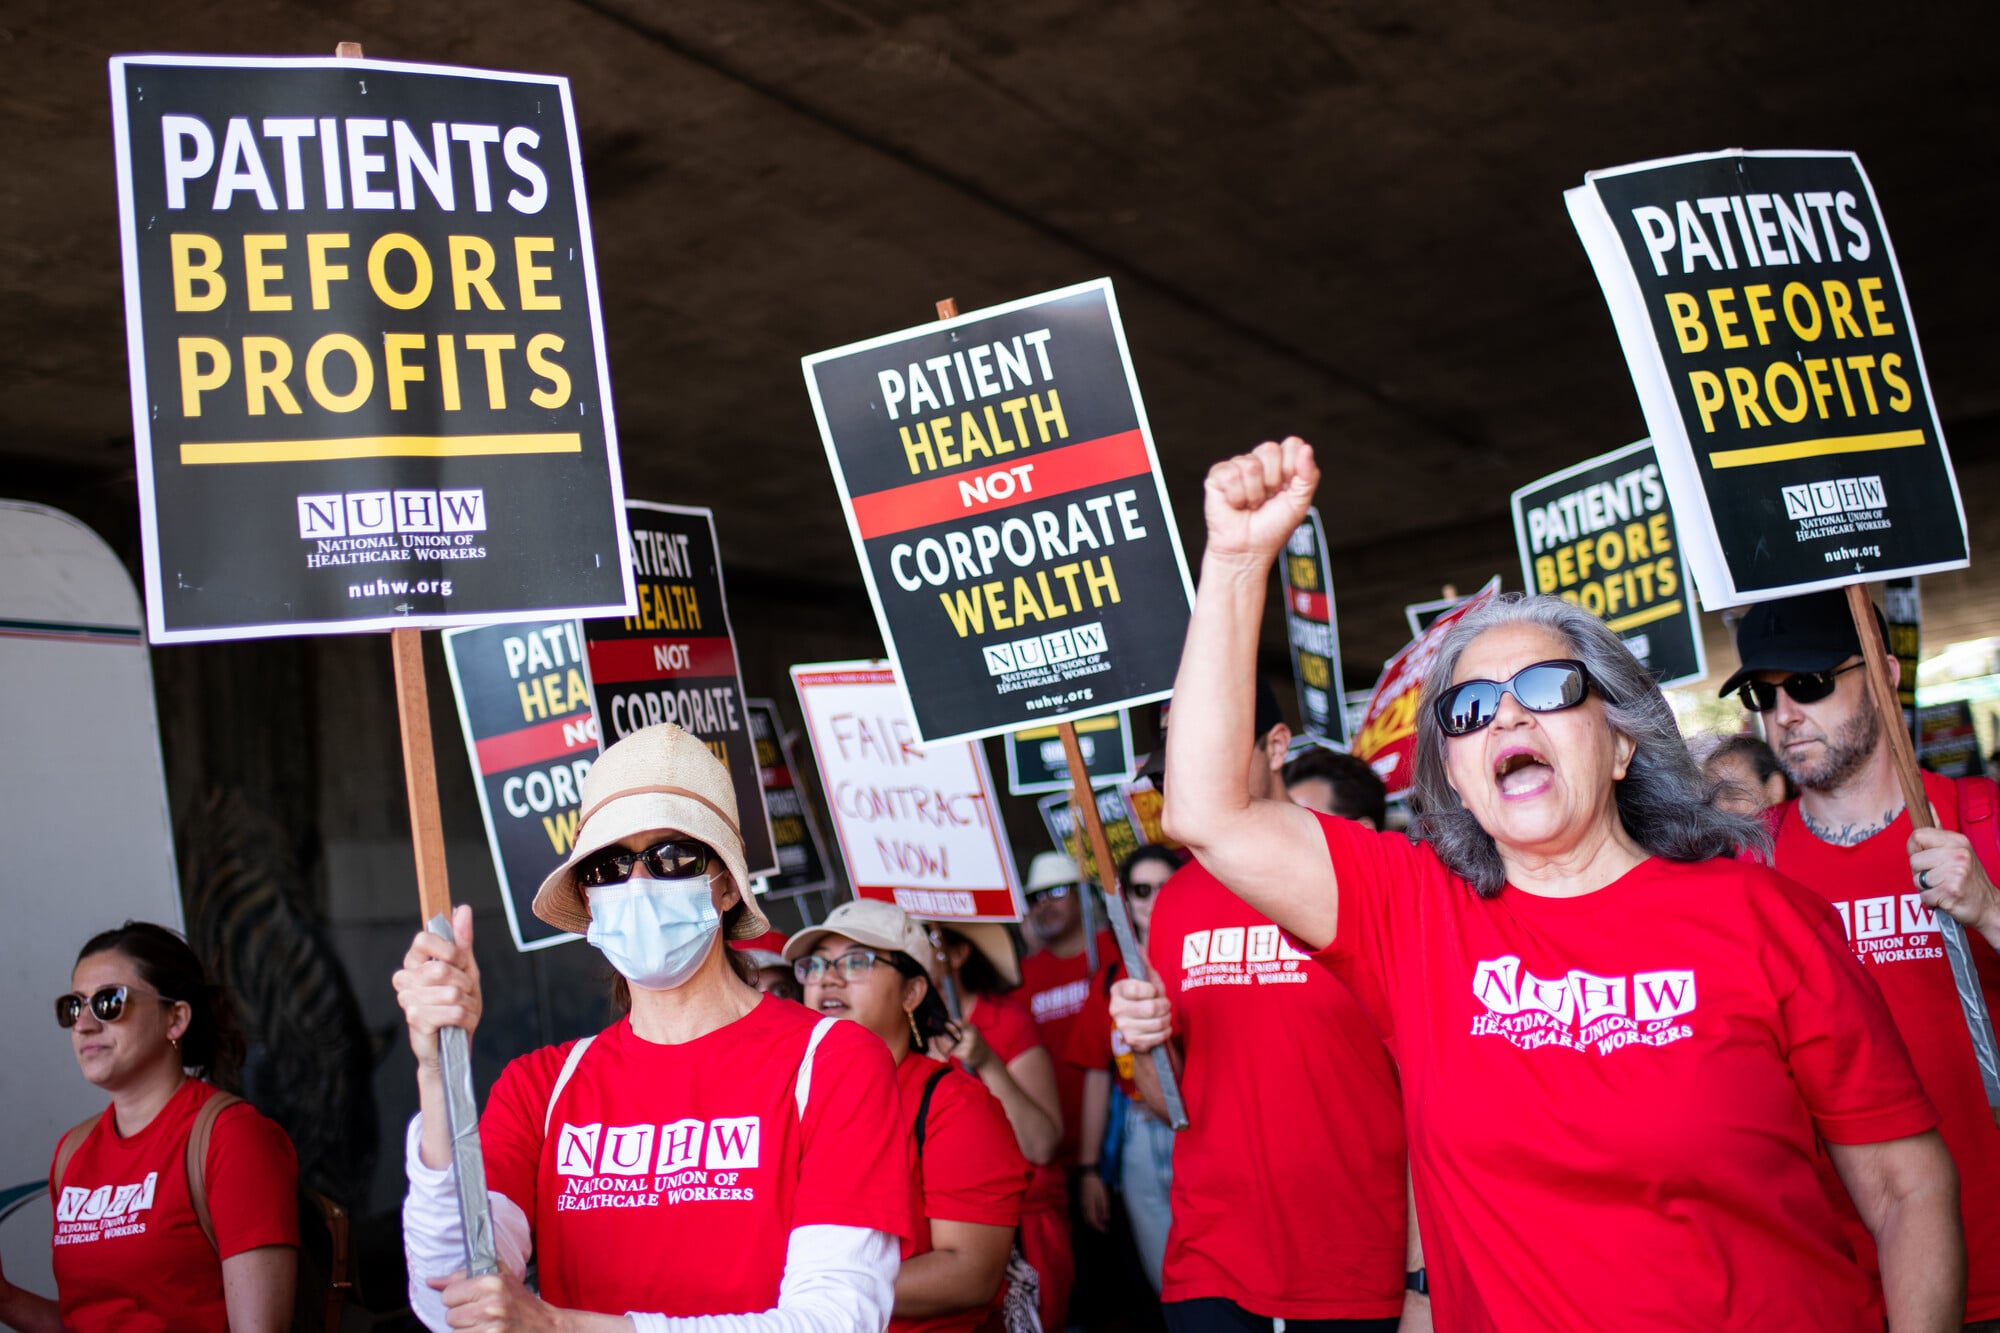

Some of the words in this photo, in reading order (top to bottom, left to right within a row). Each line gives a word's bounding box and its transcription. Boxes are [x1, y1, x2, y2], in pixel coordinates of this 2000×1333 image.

[161, 115, 548, 215] PATIENTS
[1632, 191, 1871, 276] PATIENTS
[170, 232, 562, 312] BEFORE
[1665, 277, 1895, 354] BEFORE
[177, 333, 573, 417] PROFITS
[878, 328, 1054, 420] PATIENT
[1688, 353, 1912, 433] PROFITS
[899, 389, 1069, 475] HEALTH
[958, 464, 1034, 507] NOT
[1528, 463, 1664, 554] PATIENTS
[1781, 475, 1888, 520] NUHW
[297, 489, 487, 538] NUHW
[1796, 522, 1855, 542] HEALTHCARE
[1856, 518, 1892, 532] WORKERS
[1799, 514, 1847, 531] NATIONAL
[1847, 510, 1872, 523] UNION
[1873, 509, 1884, 519] OF
[307, 549, 410, 568] HEALTHCARE
[415, 547, 487, 561] WORKERS
[317, 537, 398, 553] NATIONAL
[402, 535, 451, 548] UNION
[454, 534, 474, 546] OF
[890, 490, 1147, 592] CORPORATE
[1535, 513, 1672, 593] BEFORE
[1824, 545, 1881, 562] nuhw.org
[349, 578, 453, 598] nuhw.org
[940, 556, 1121, 638] WEALTH
[1561, 556, 1678, 617] OFITS
[503, 622, 582, 679] PATI
[653, 644, 690, 671] NOT
[982, 621, 1109, 677] NUHW
[1001, 666, 1051, 683] NATIONAL
[1052, 658, 1086, 674] UNION
[1087, 653, 1101, 664] OF
[518, 668, 590, 722] HEA
[996, 675, 1060, 695] HEALTHCARE
[1062, 661, 1112, 681] WORKERS
[1026, 688, 1093, 710] nuhw.org
[562, 717, 598, 747] NO
[611, 687, 739, 740] CORPORATE
[831, 714, 925, 766] FAIR
[836, 781, 987, 828] CONTRACT
[876, 837, 949, 880] NOW
[1182, 924, 1312, 969] NUH
[1857, 936, 1904, 953] UNION
[1909, 935, 1929, 947] OF
[1872, 947, 1943, 965] WORKERS
[1473, 955, 1697, 1027] NUHW
[1470, 1015, 1586, 1052] HEALTHCARE
[1597, 1025, 1694, 1056] WORKERS
[1485, 1009, 1573, 1037] NATIONAL
[1580, 1015, 1639, 1045] UNION
[1646, 1018, 1674, 1032] OF
[557, 1116, 760, 1177] NUHW
[558, 1193, 659, 1211] HEALTHCARE
[668, 1187, 754, 1205] WORKERS
[565, 1177, 648, 1195] NATIONAL
[653, 1171, 707, 1192] UNION
[714, 1172, 739, 1186] OF
